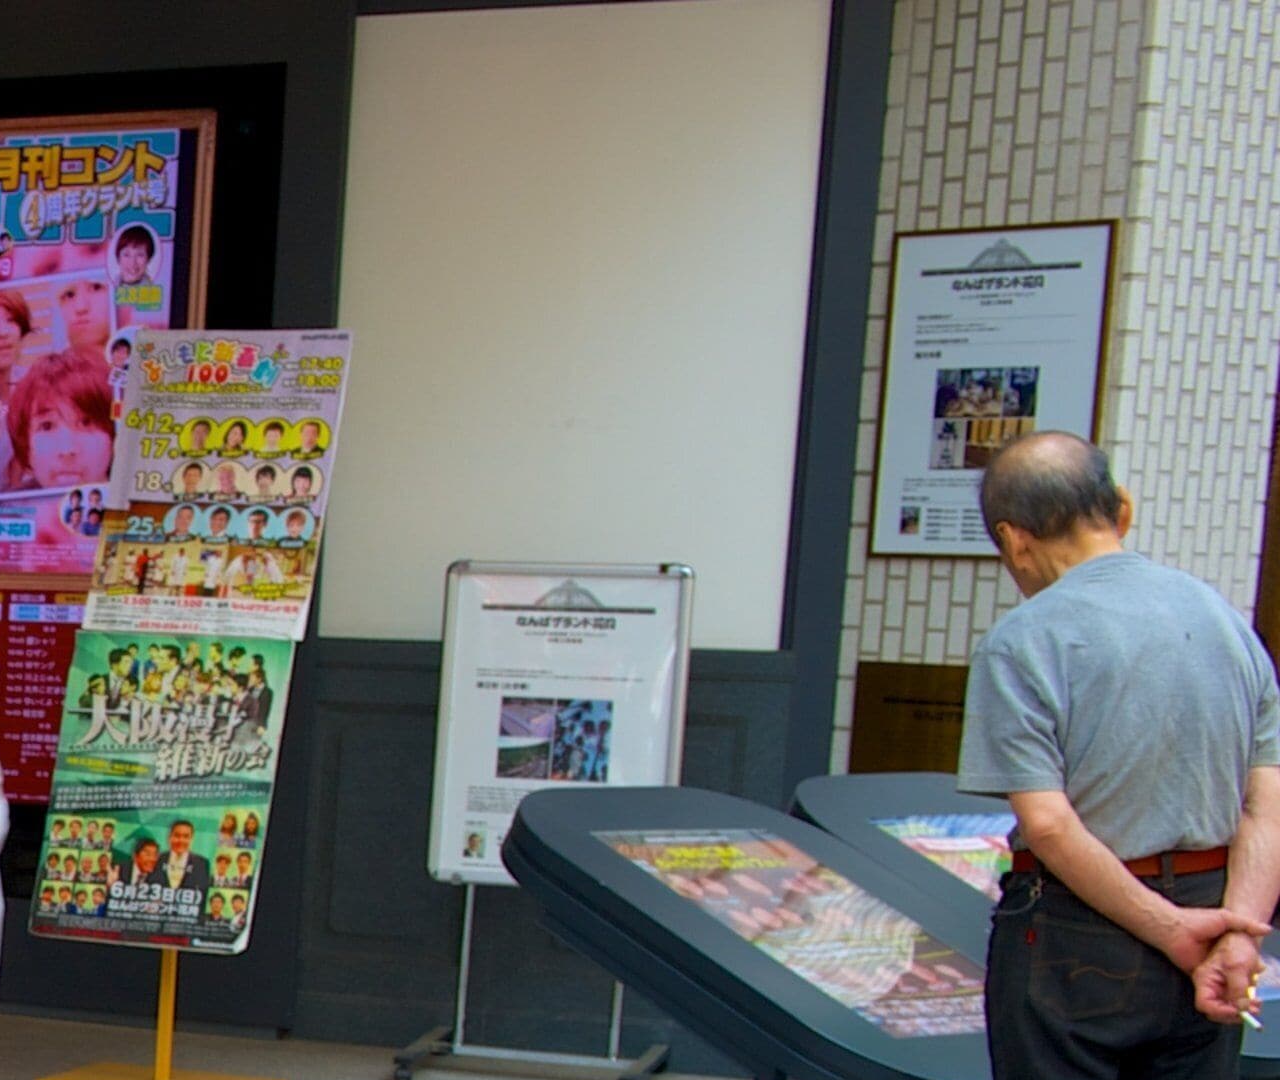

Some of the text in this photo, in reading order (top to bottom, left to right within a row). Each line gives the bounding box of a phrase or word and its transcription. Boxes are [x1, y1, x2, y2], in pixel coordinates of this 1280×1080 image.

[127, 515, 155, 536] 25
[67, 694, 248, 746] 大阪漫才
[155, 741, 272, 782] 維新の会
[109, 881, 203, 905] 6月23日(日)
